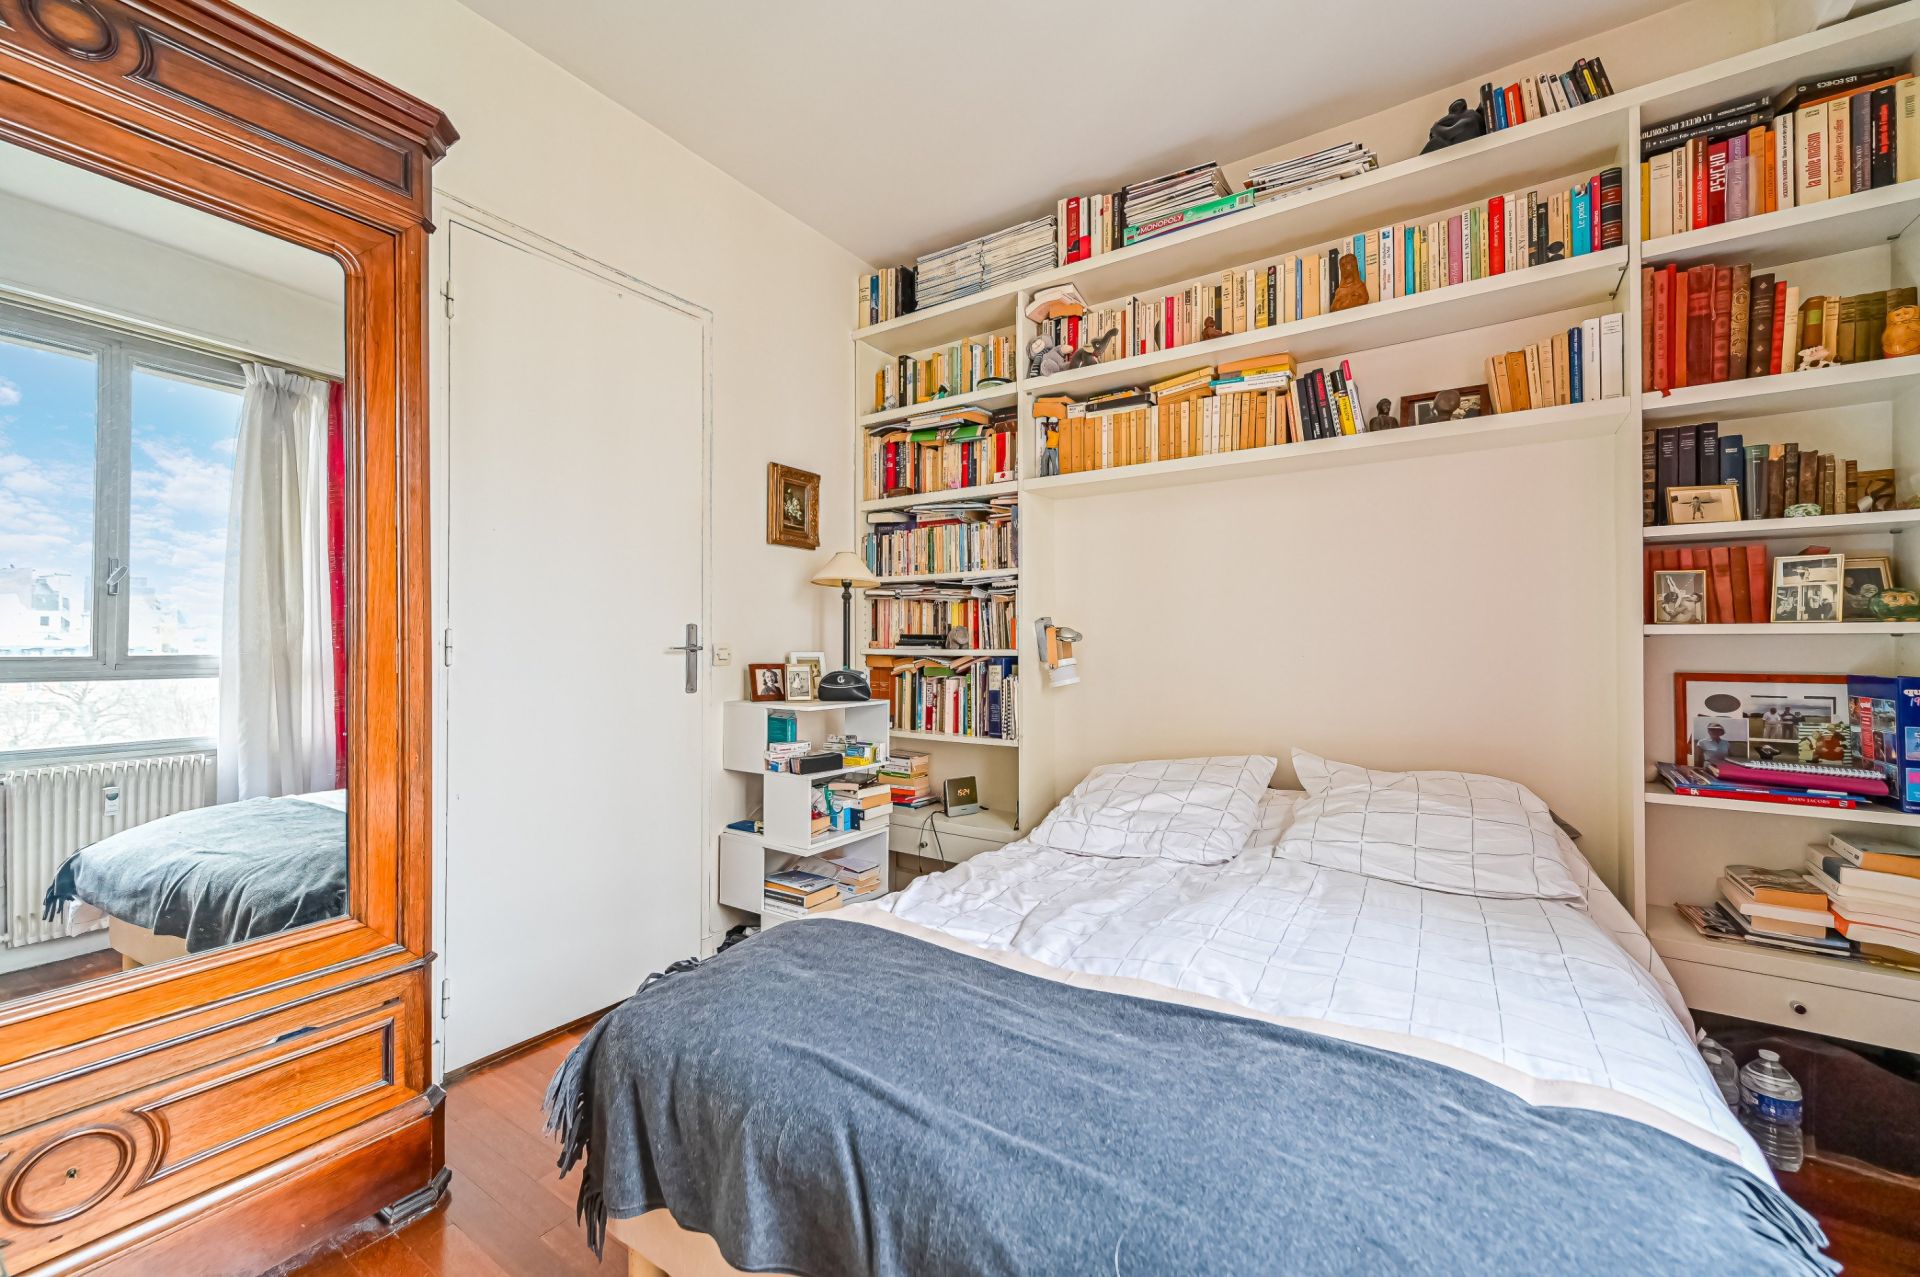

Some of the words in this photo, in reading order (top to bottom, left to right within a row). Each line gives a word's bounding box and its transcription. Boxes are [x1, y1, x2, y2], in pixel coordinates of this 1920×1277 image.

[1845, 75, 1858, 83] LES
[1702, 113, 1712, 123] LA
[1805, 132, 1821, 159] maison
[1710, 152, 1726, 192] PSYCHO
[1805, 159, 1822, 179] noble
[1576, 202, 1587, 219] poids
[1139, 212, 1184, 235] MONOPOLY
[1465, 251, 1469, 259] LE
